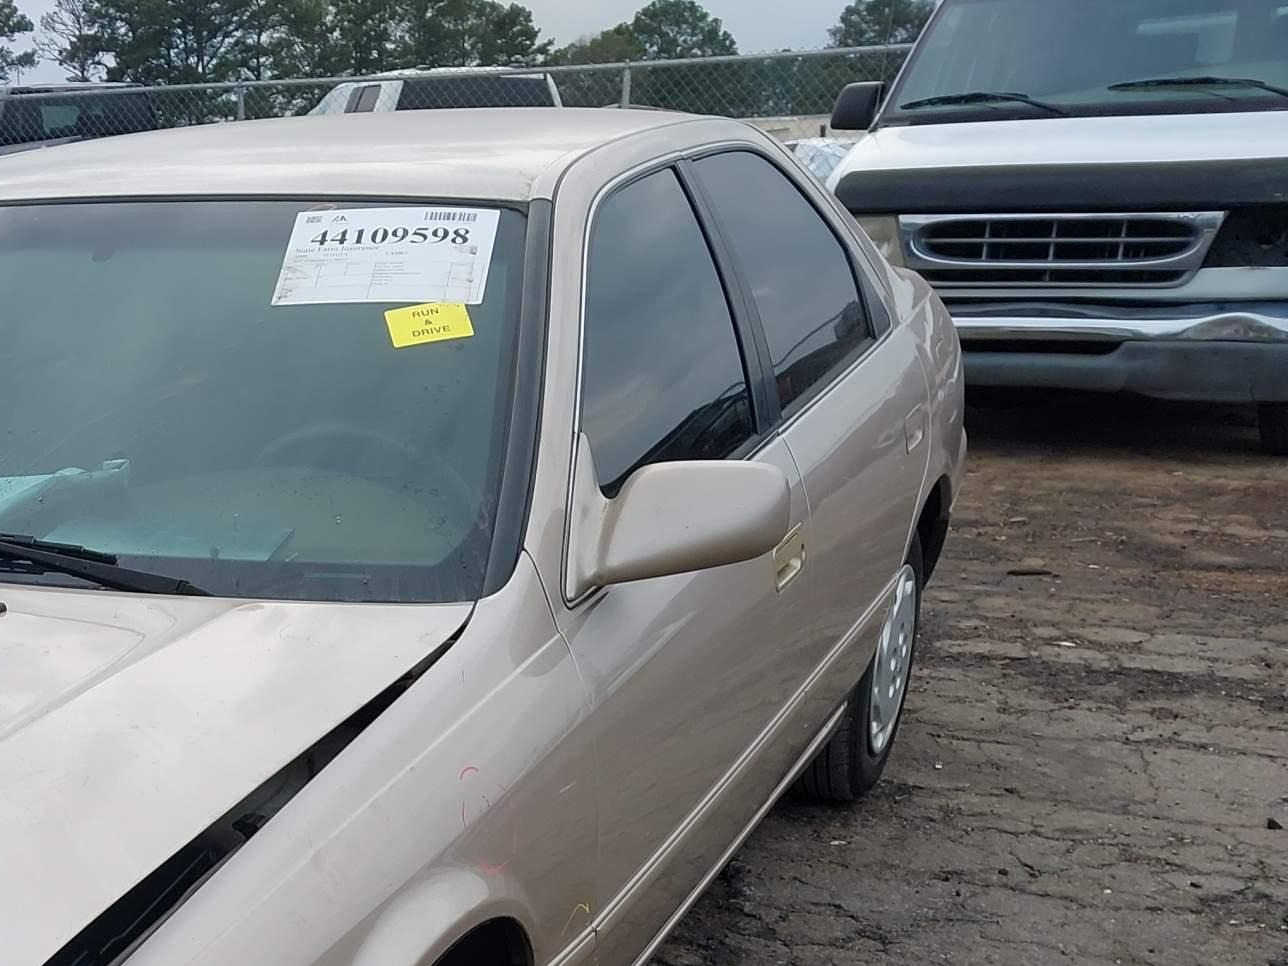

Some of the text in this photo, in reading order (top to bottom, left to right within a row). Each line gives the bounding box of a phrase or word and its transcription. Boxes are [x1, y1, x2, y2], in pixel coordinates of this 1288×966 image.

[310, 227, 470, 246] 44109598
[412, 308, 439, 318] RUN
[412, 325, 451, 337] DRIVE
